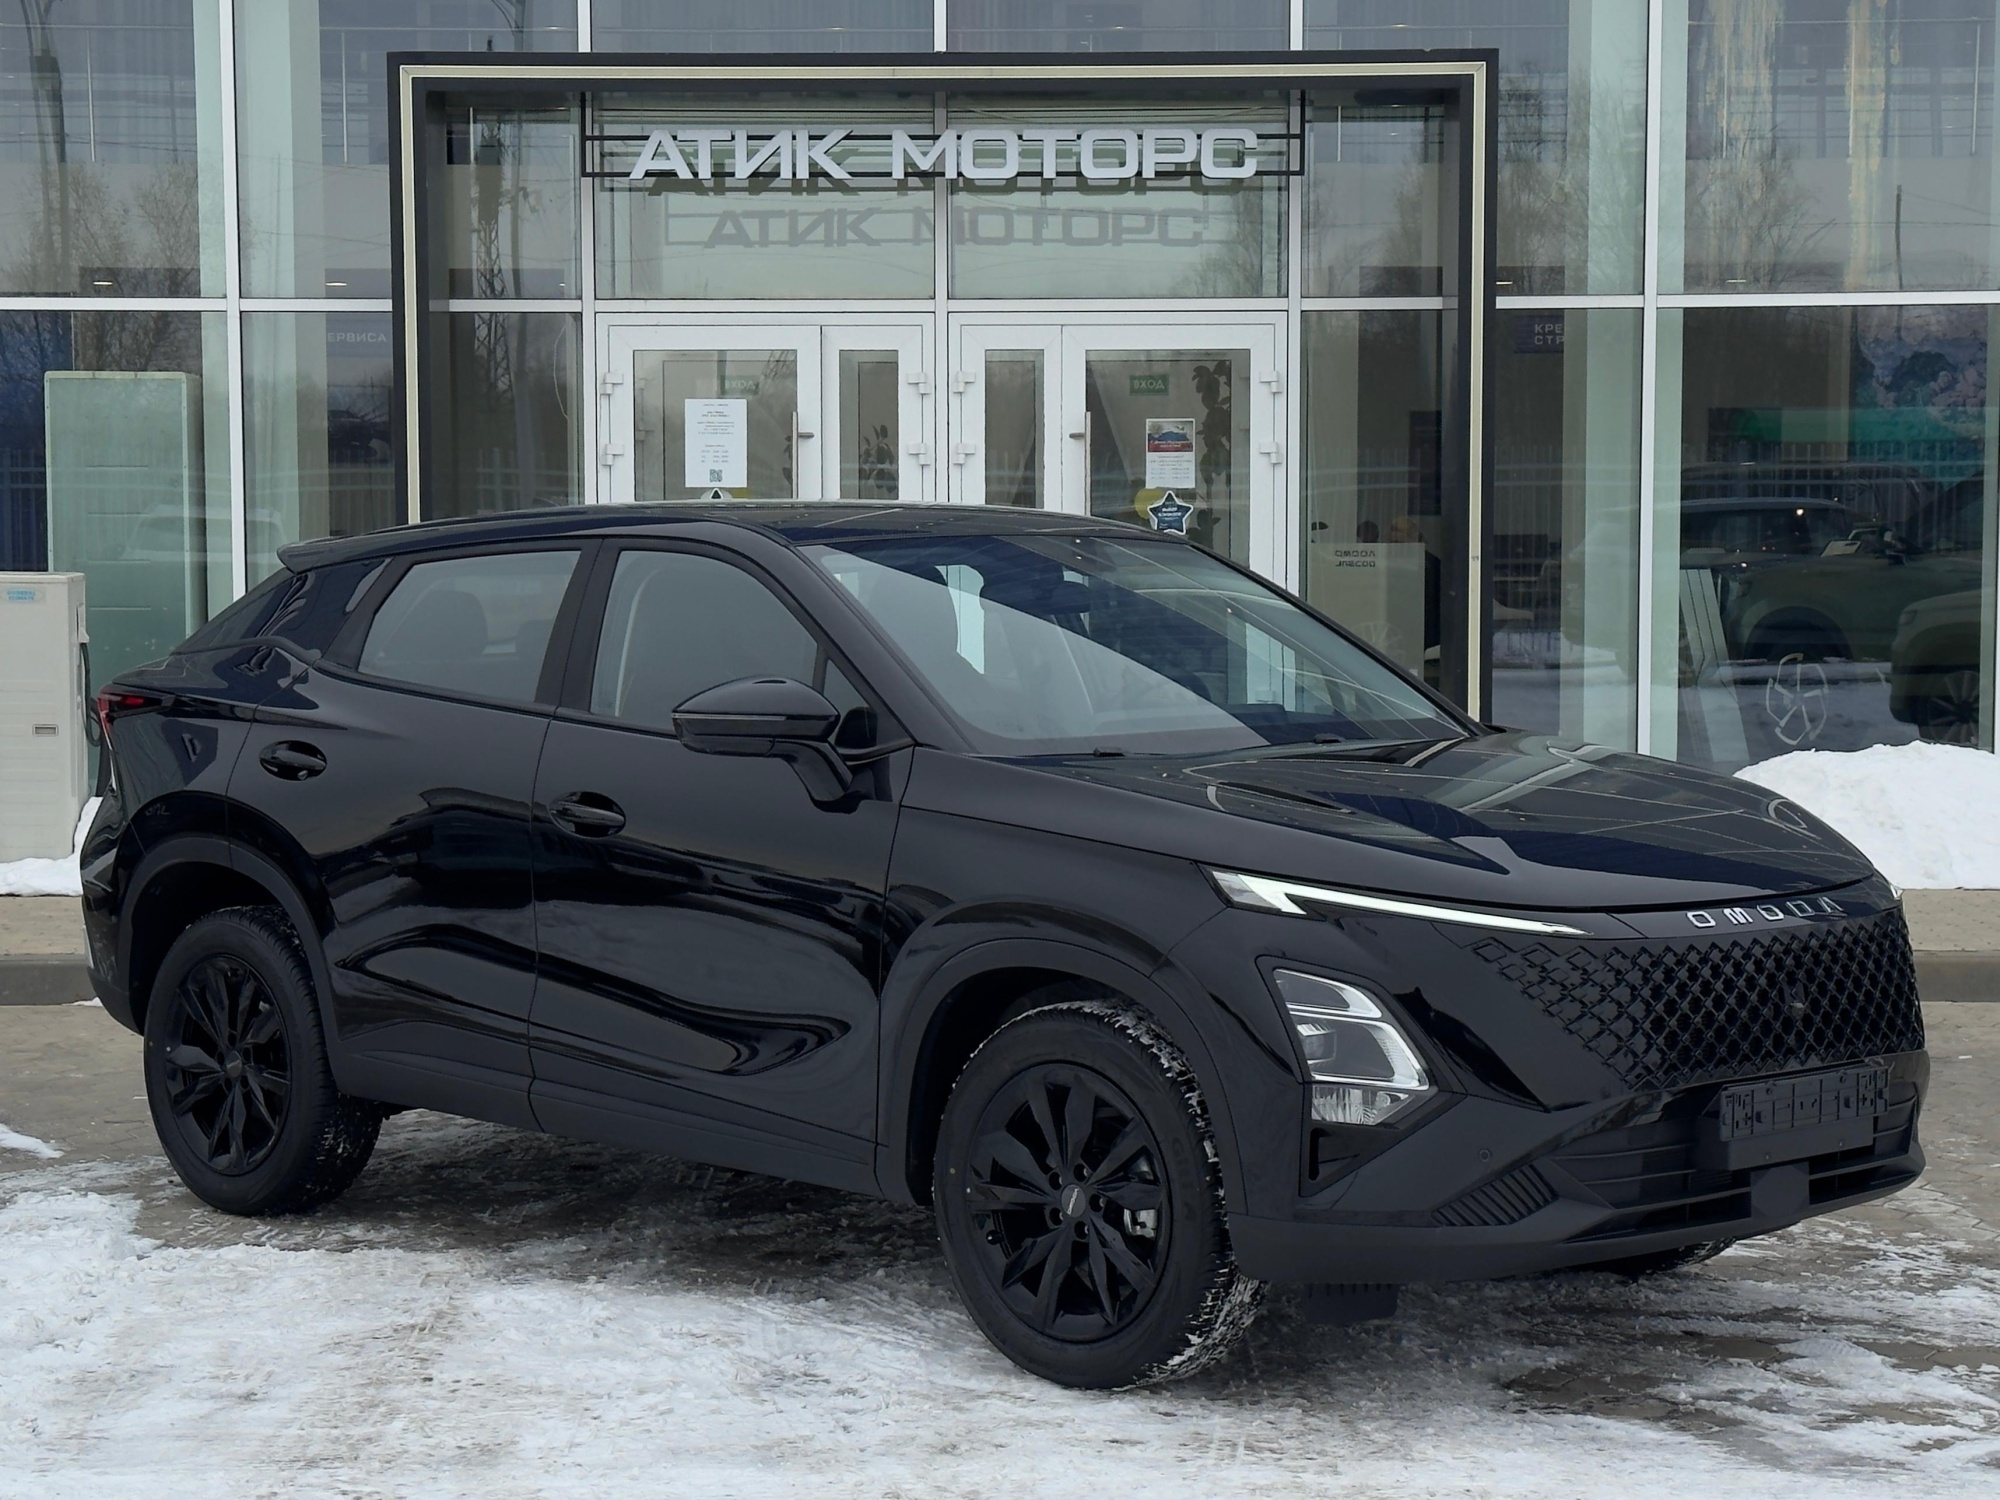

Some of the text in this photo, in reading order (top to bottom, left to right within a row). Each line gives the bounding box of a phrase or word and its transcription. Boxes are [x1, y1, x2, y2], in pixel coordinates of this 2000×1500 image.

[629, 128, 1257, 180] АТИК МОТОРС
[703, 207, 881, 248] АТИК
[1133, 379, 1165, 390] ВХОД
[1686, 897, 1844, 928] OMODA
